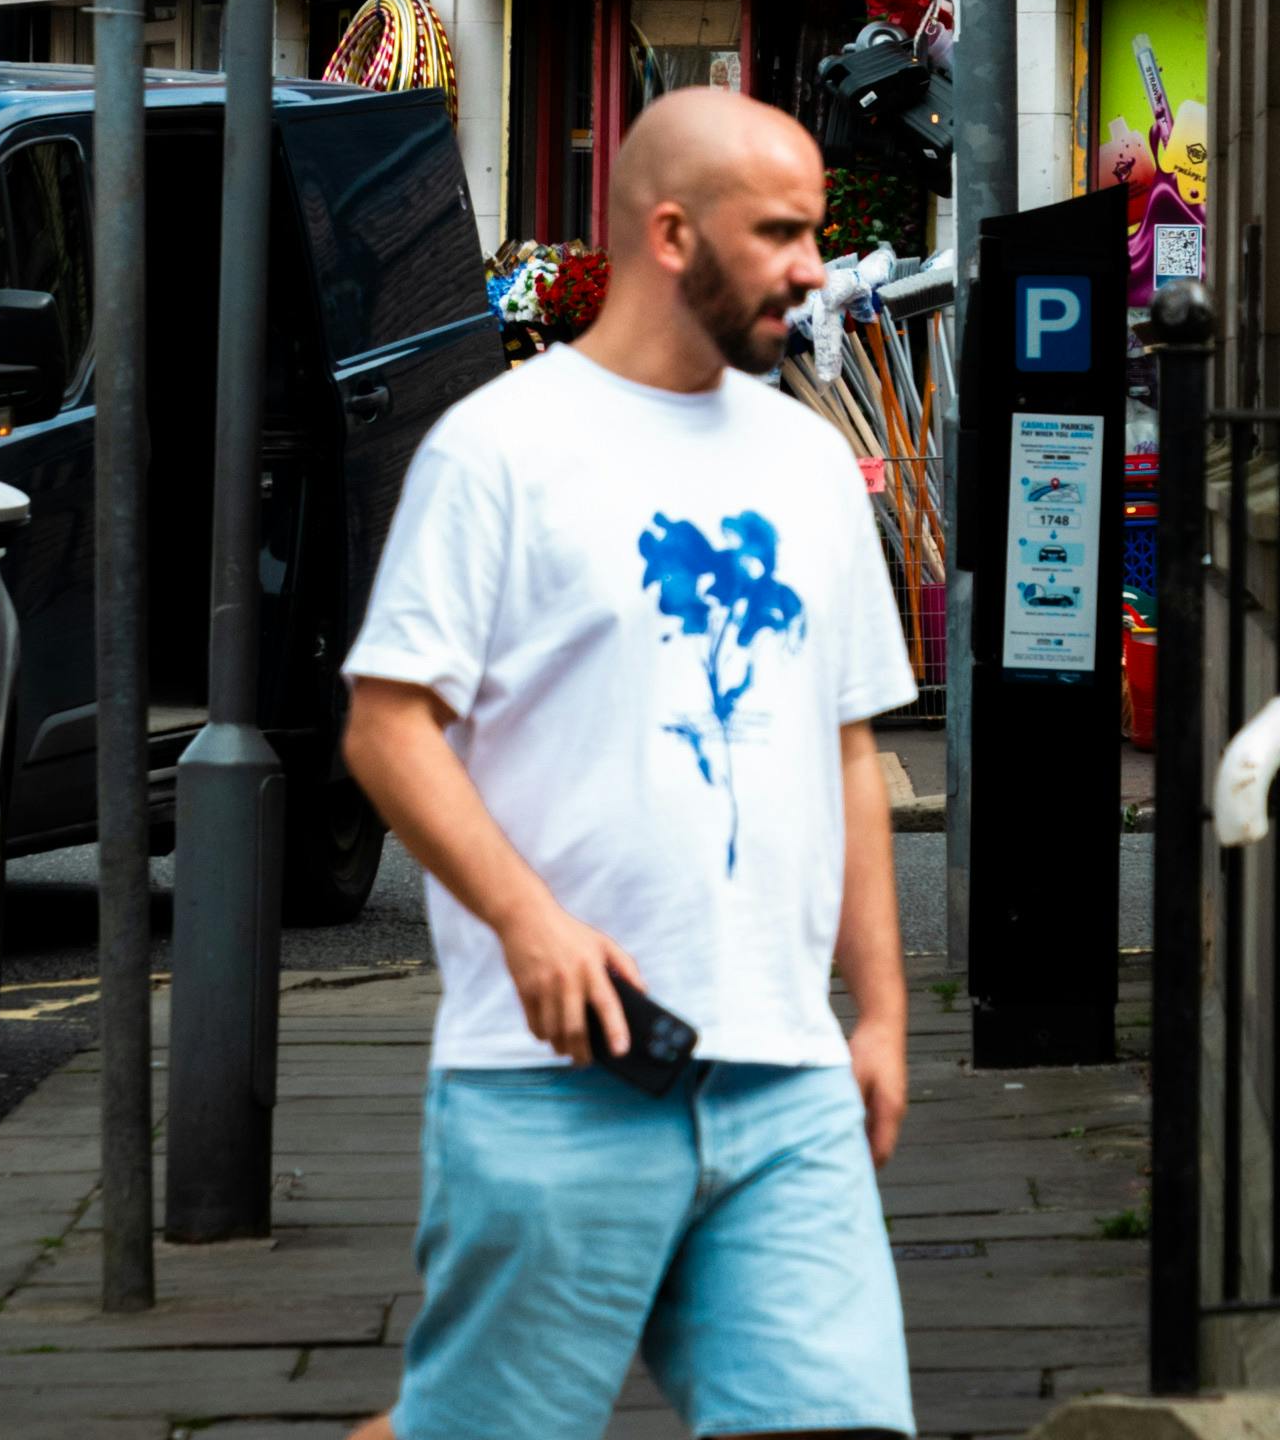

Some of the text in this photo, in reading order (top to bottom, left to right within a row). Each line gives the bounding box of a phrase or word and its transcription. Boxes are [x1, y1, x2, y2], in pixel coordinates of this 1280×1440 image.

[1026, 288, 1081, 359] P
[1060, 423, 1095, 431] PARKING
[1040, 515, 1070, 526] 1748
